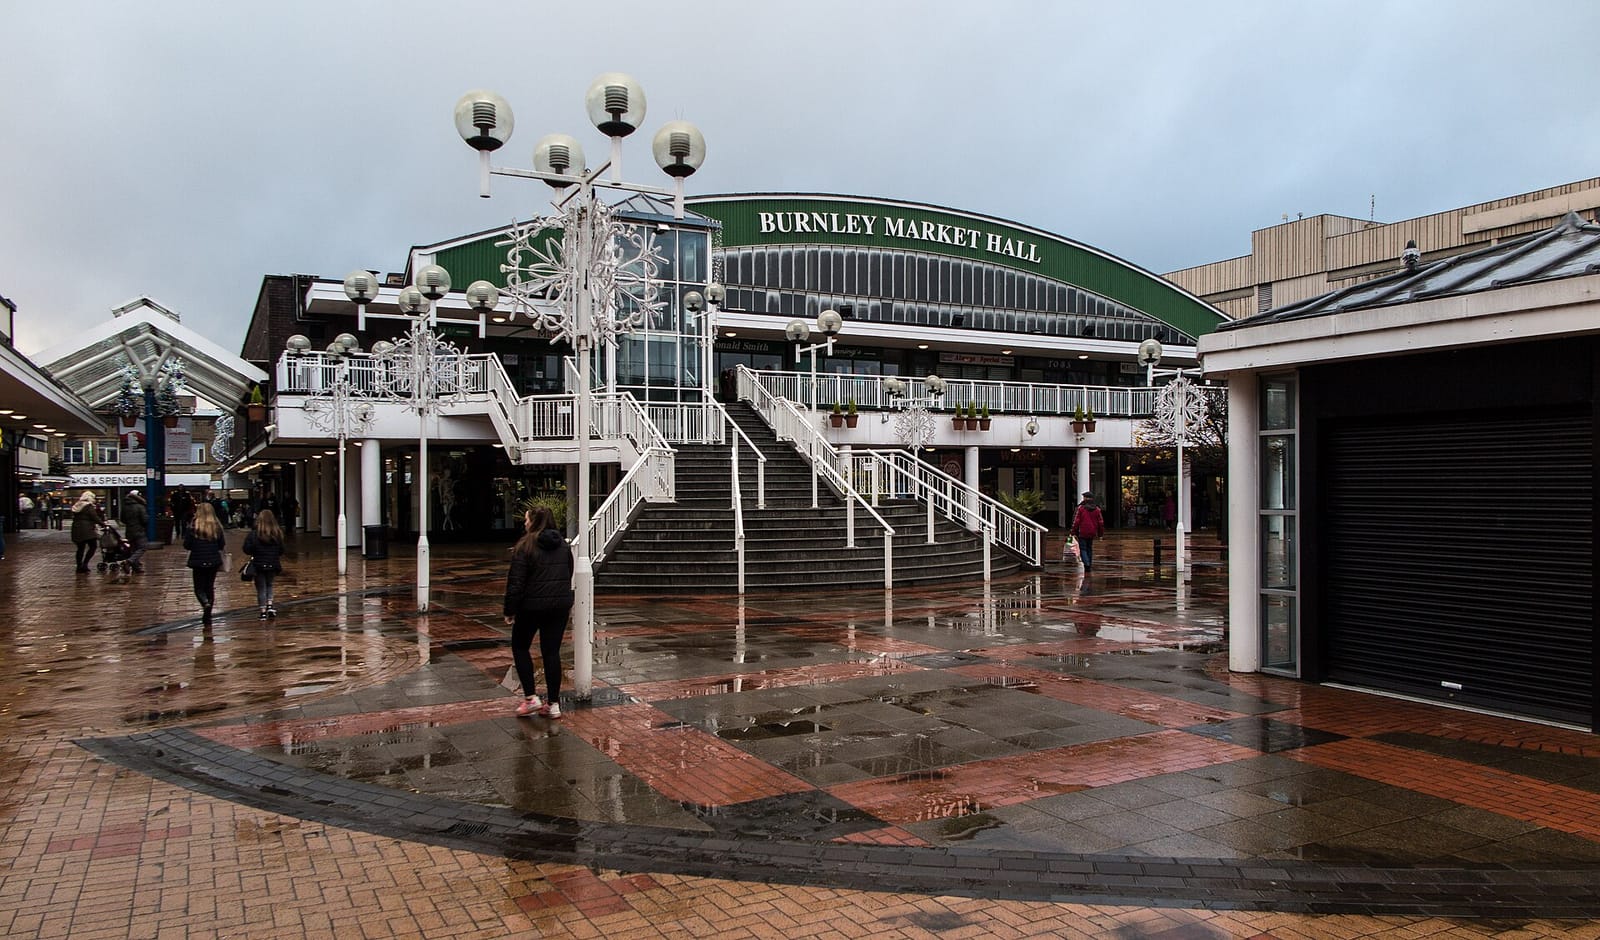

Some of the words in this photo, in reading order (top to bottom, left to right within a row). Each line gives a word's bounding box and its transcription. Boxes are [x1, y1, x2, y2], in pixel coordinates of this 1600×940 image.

[758, 211, 877, 235] BURNLEY
[884, 216, 981, 249] MARKET
[986, 233, 1042, 263] HALL
[714, 340, 741, 350] onald
[742, 341, 769, 352] Smith
[91, 477, 97, 485] &
[98, 476, 145, 485] SPENCER
